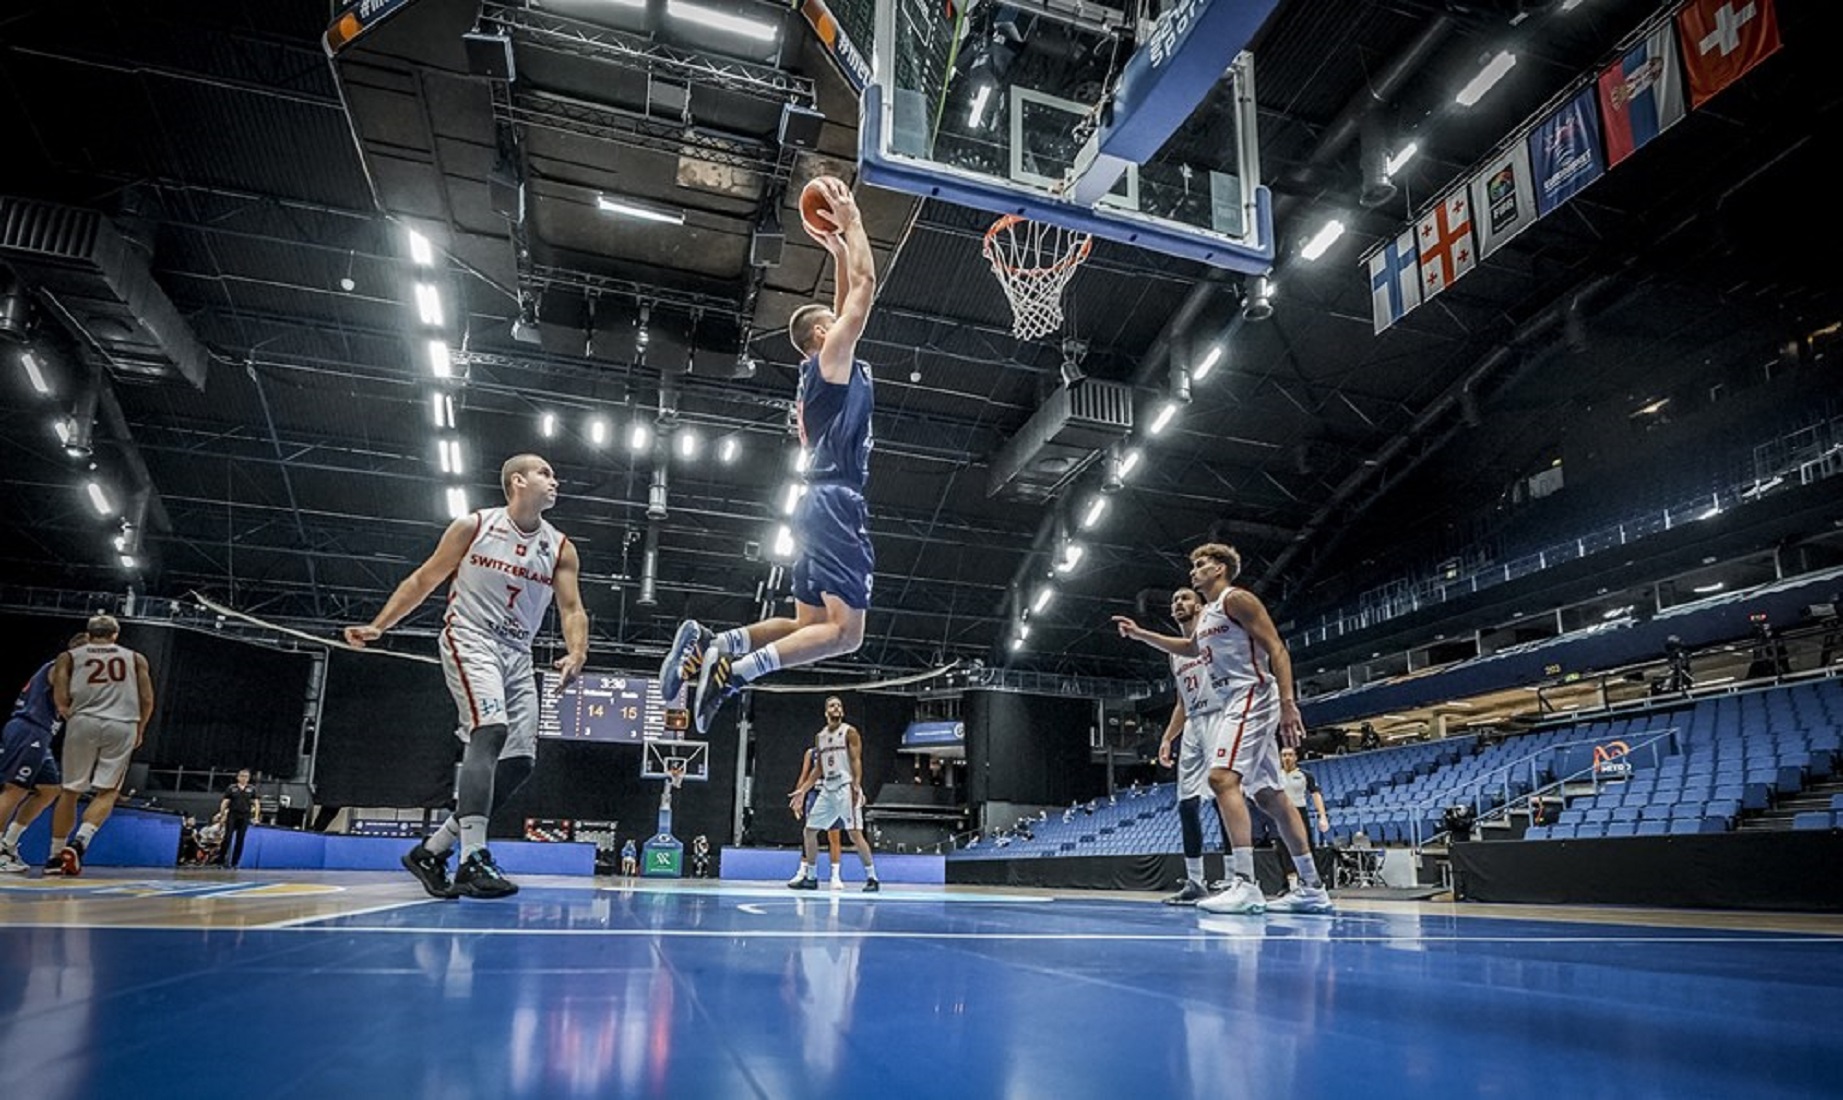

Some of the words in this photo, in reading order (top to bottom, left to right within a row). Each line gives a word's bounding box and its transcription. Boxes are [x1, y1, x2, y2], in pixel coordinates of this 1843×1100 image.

[469, 554, 553, 586] SWITZERLAND
[506, 584, 522, 609] 7
[85, 656, 126, 684] 20
[1184, 675, 1198, 692] 21
[588, 704, 605, 718] 14
